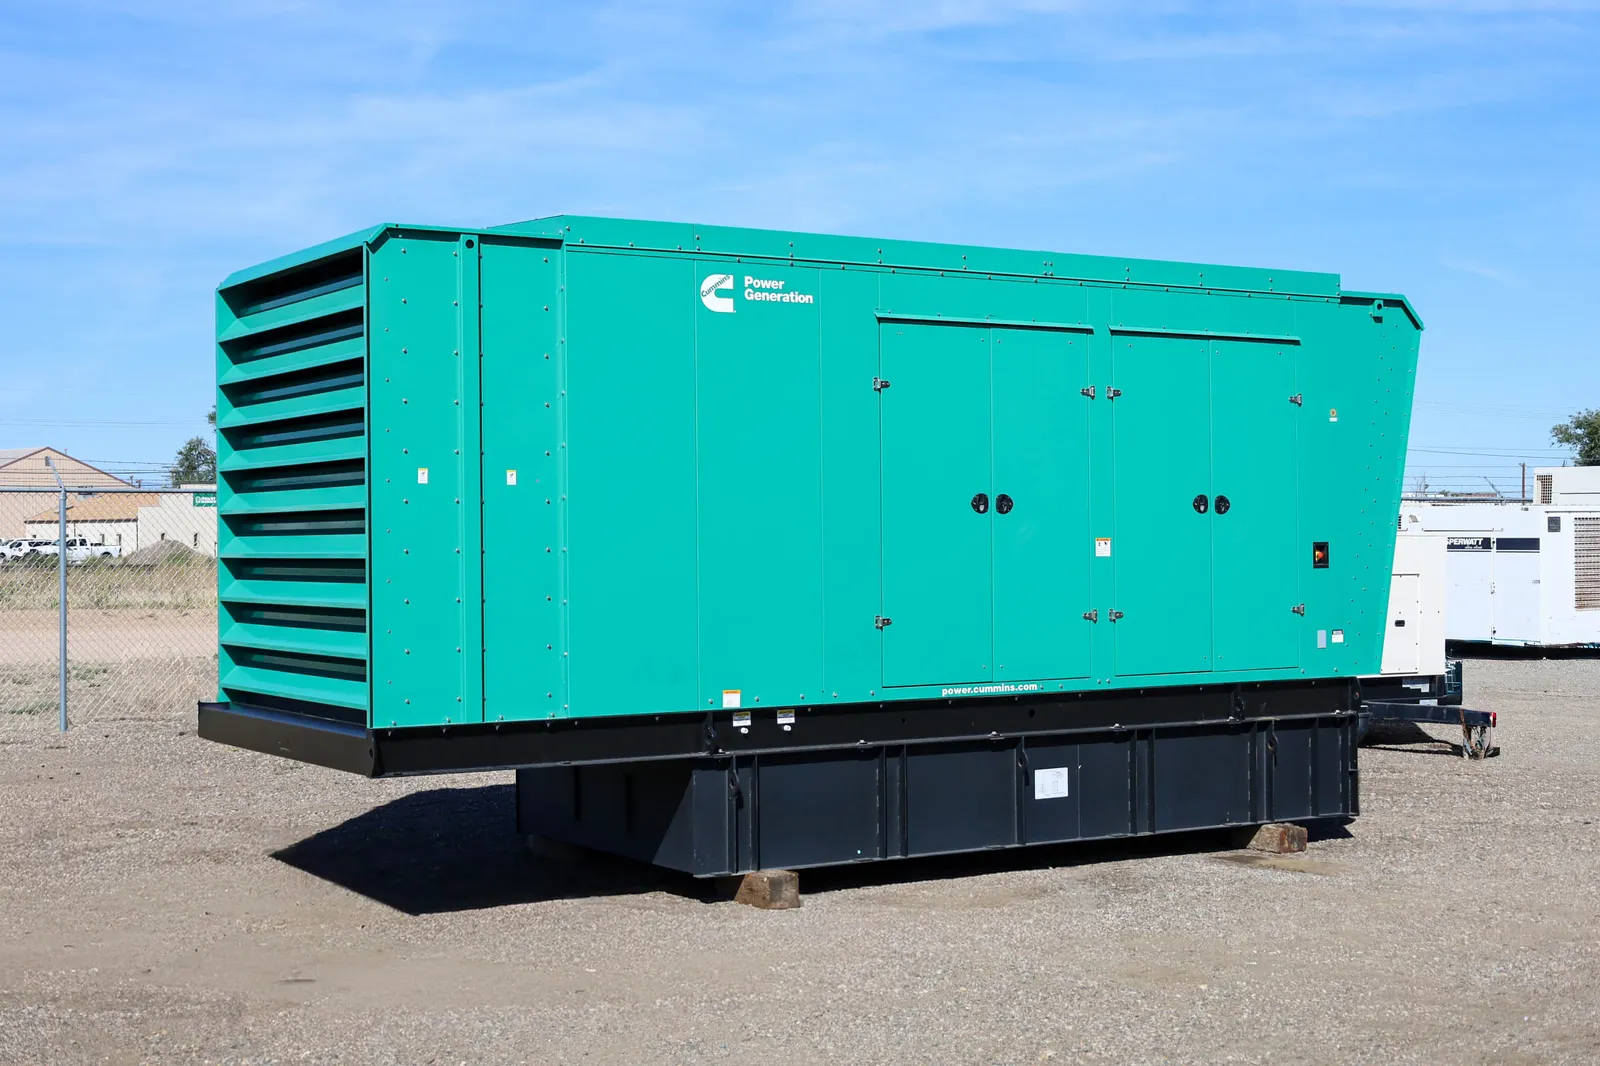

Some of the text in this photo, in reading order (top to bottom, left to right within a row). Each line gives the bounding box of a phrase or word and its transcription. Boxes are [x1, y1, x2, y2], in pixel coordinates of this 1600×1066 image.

[701, 274, 731, 298] Cummins
[744, 275, 785, 290] Power
[744, 288, 814, 304] Generation
[941, 683, 1038, 697] power.cummins.com
